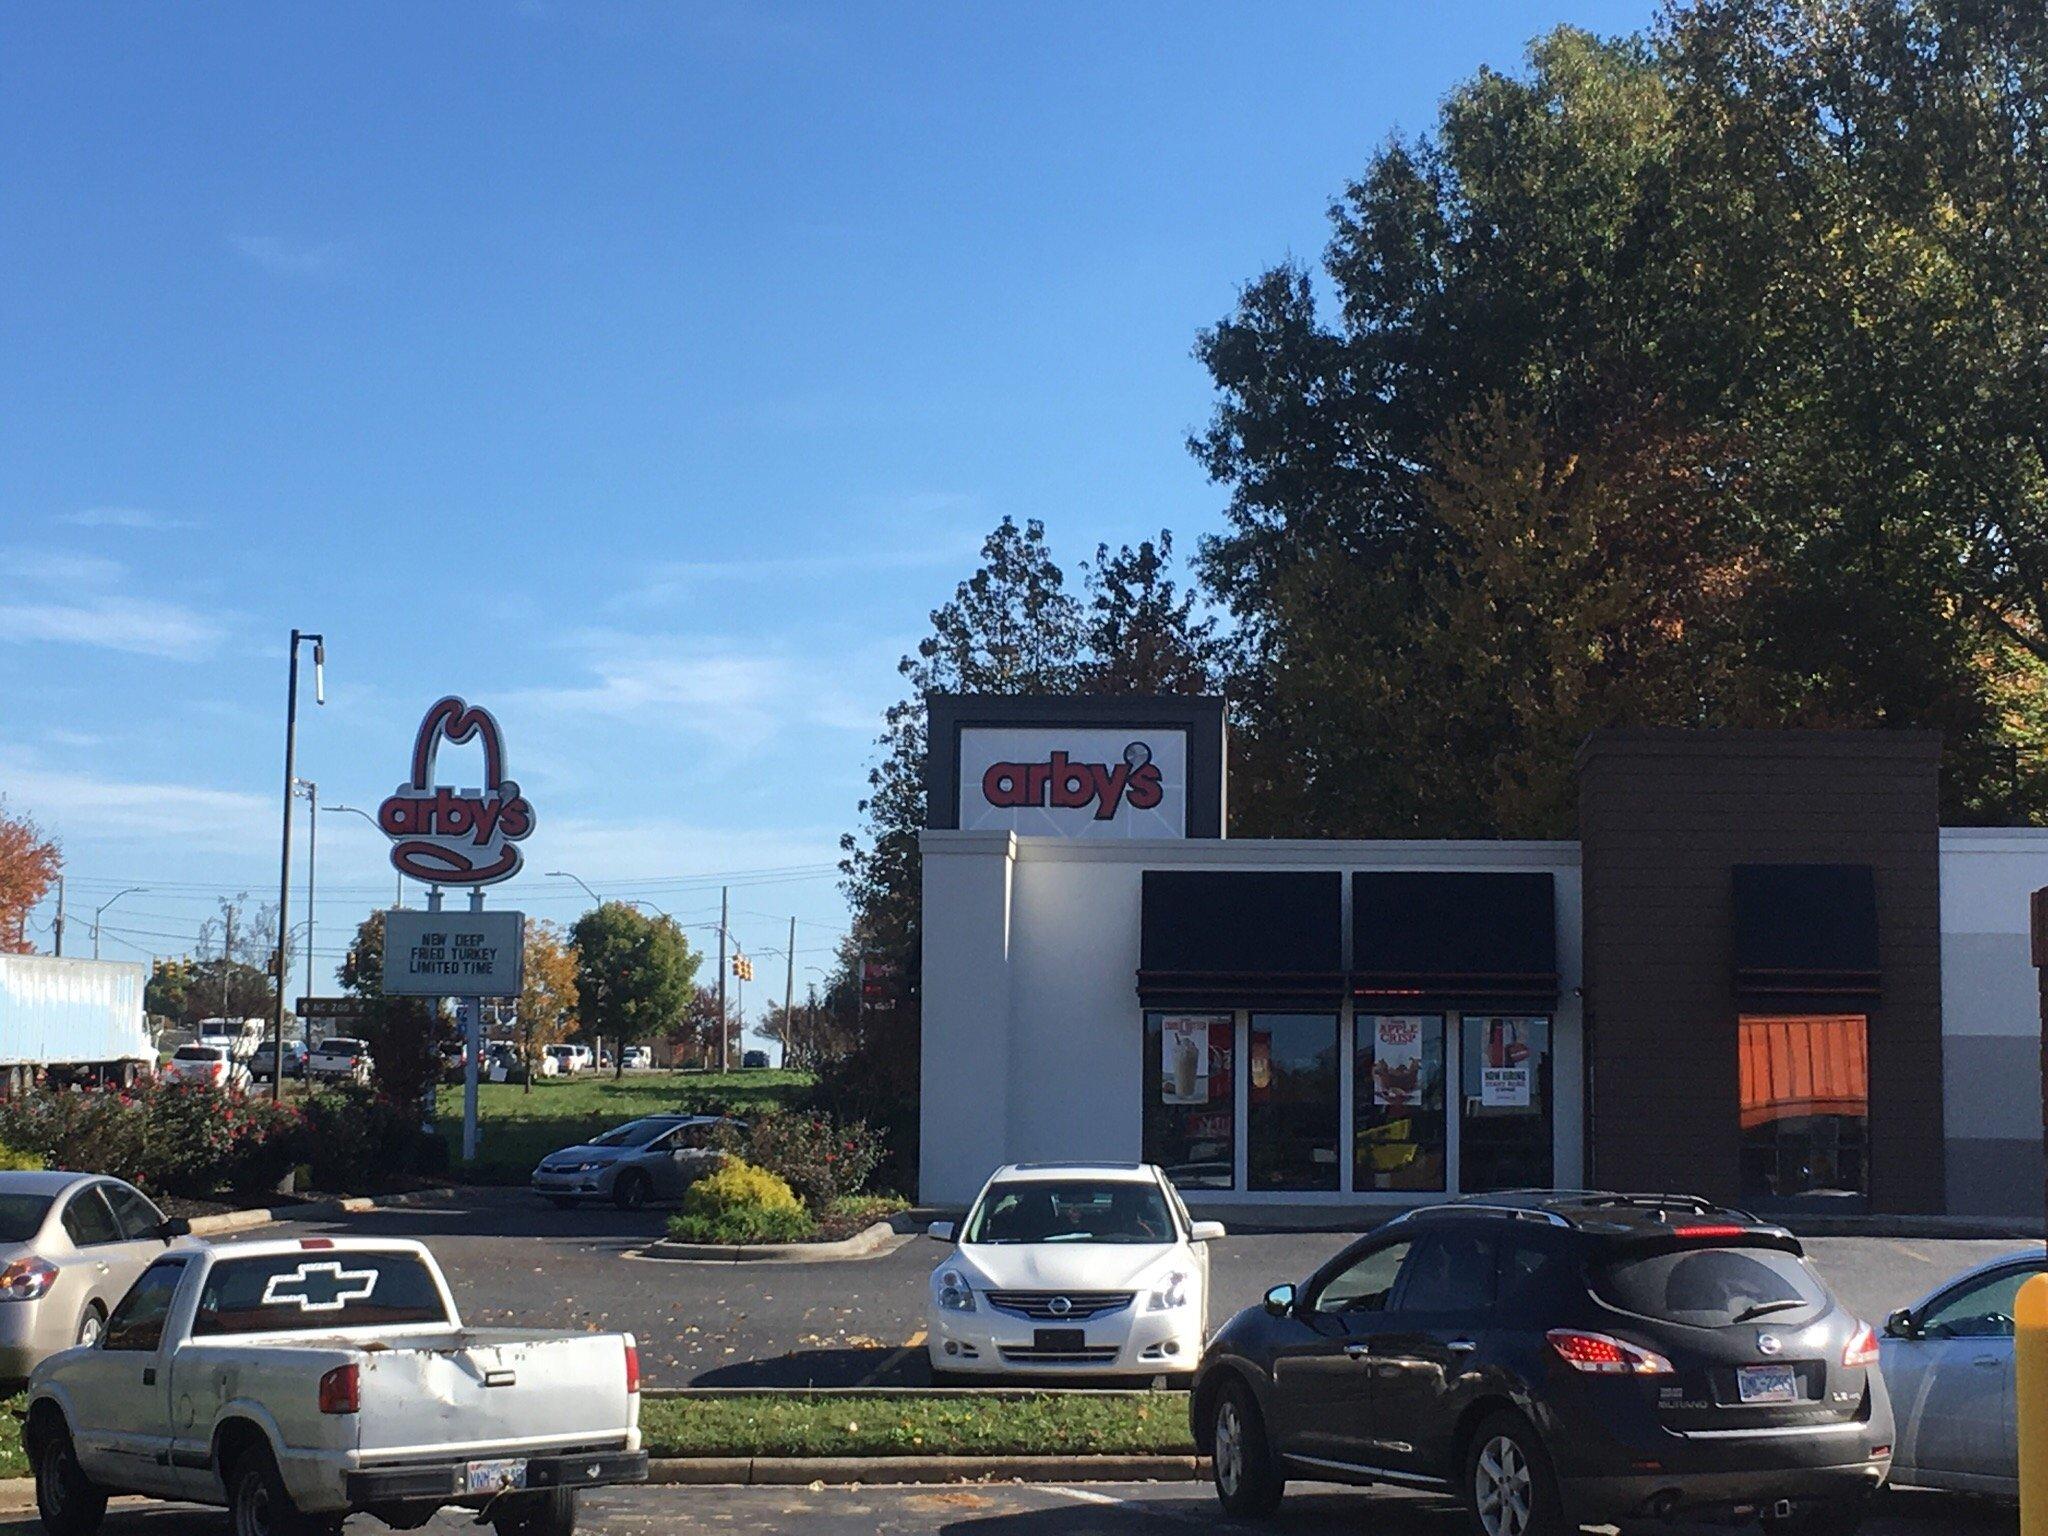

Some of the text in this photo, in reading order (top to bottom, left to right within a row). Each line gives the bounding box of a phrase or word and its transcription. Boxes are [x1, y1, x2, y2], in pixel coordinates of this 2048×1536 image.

[982, 741, 1164, 820] arby's
[379, 781, 531, 846] arby's
[422, 933, 485, 947] NEW DEEP
[411, 947, 497, 960] FRIED TURKEY
[409, 961, 494, 974] LIMITED TIME
